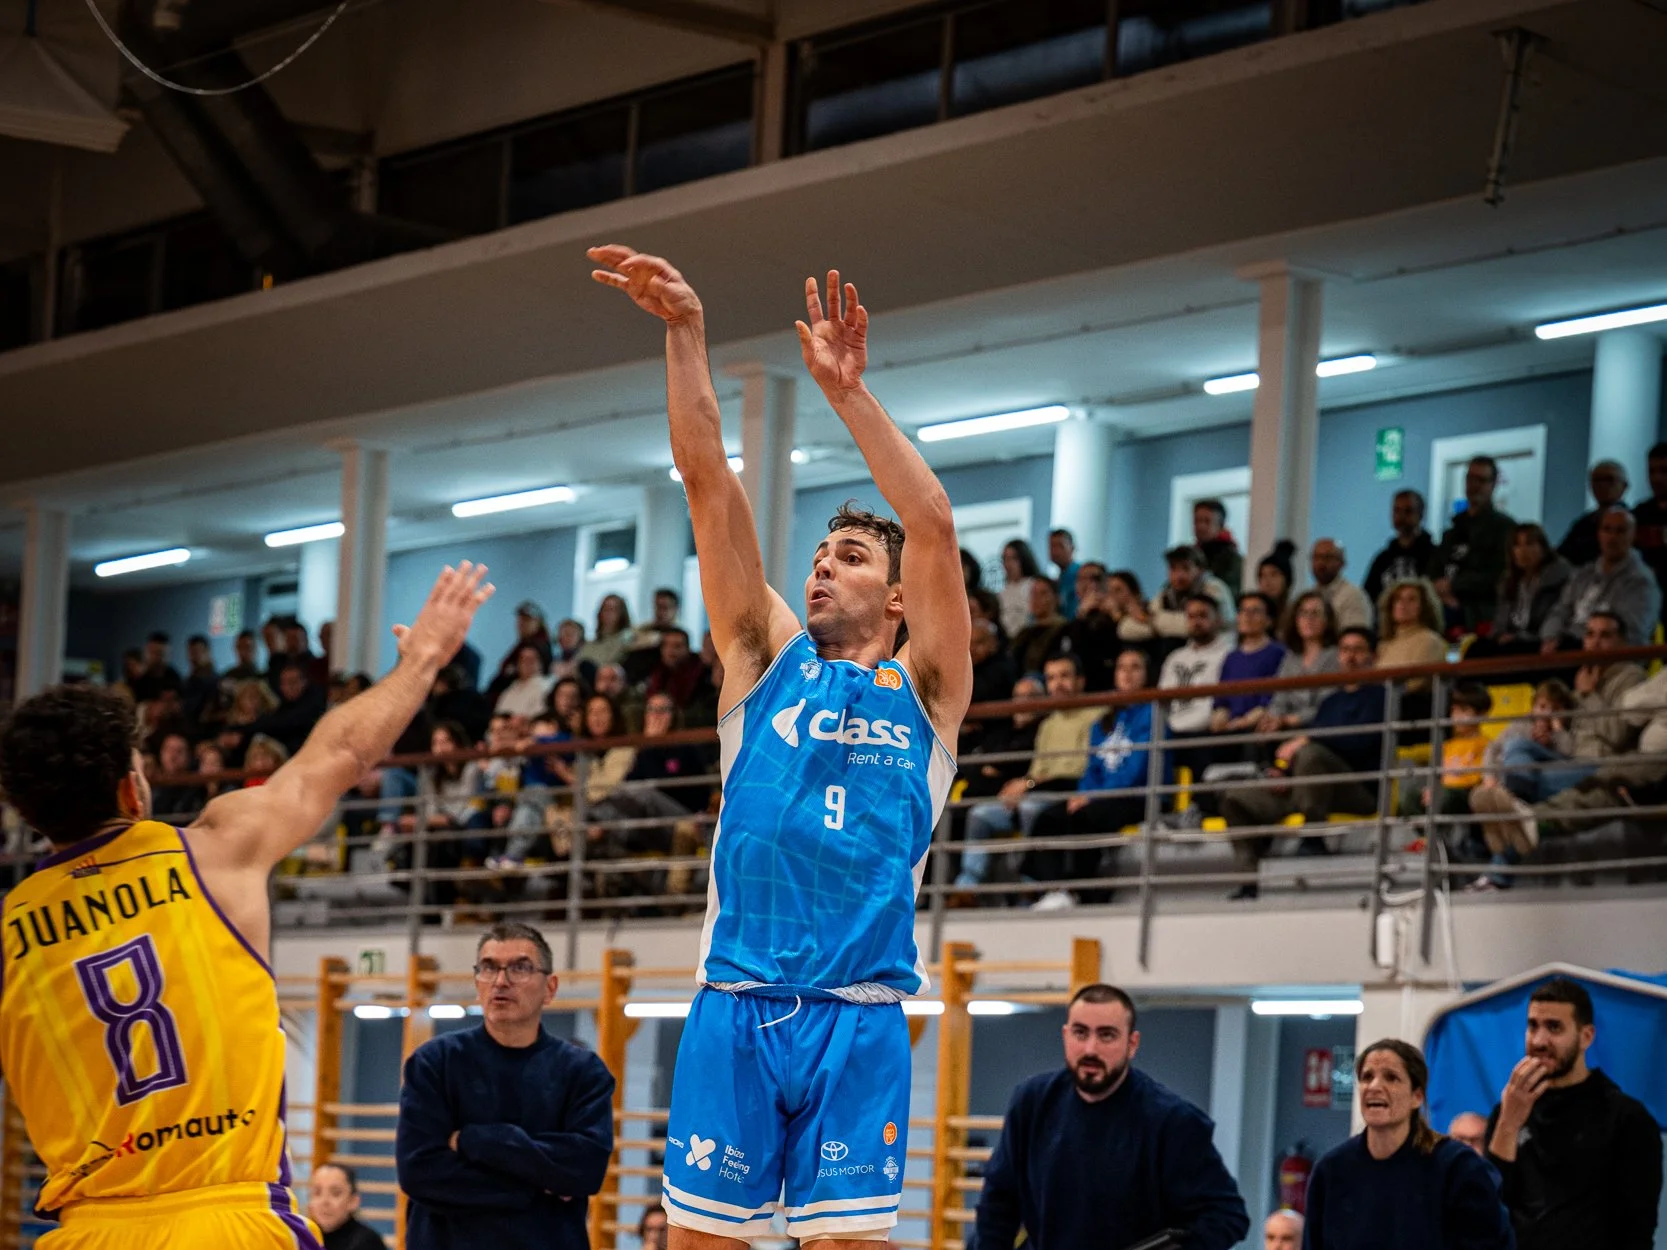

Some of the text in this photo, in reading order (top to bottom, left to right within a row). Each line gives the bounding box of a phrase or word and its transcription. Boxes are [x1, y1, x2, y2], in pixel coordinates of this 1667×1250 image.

[808, 708, 912, 750] Class
[847, 751, 916, 771] Rent a car
[823, 784, 847, 831] 9
[8, 866, 192, 960] JUANOLA
[73, 932, 190, 1108] 8
[722, 1154, 750, 1175] Feeing
[724, 1144, 745, 1160] Ibiza
[839, 1164, 875, 1176] MOTOR
